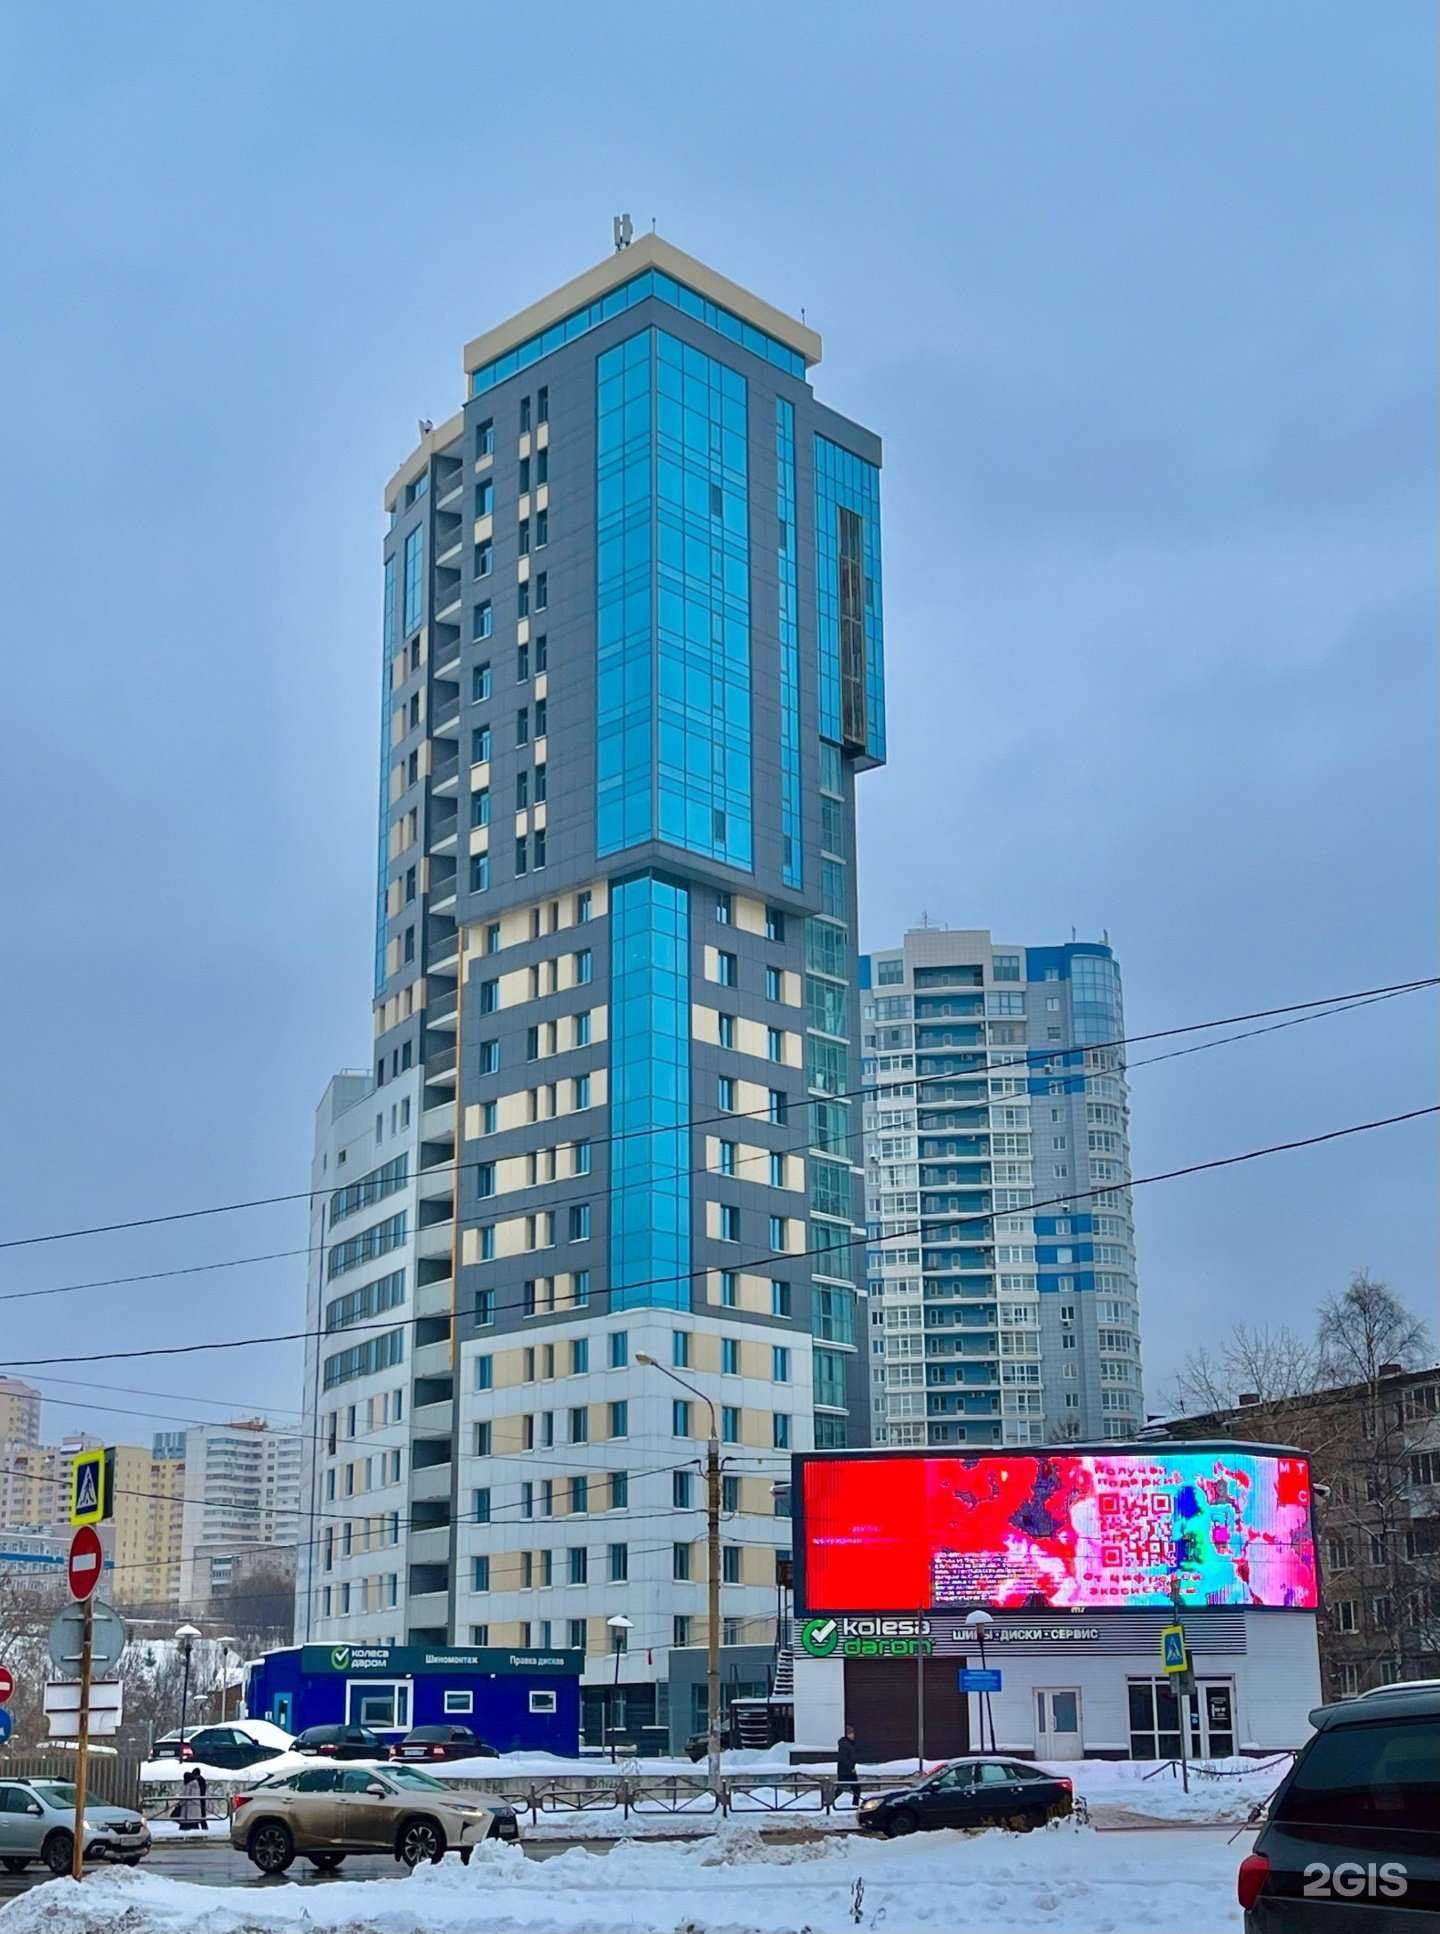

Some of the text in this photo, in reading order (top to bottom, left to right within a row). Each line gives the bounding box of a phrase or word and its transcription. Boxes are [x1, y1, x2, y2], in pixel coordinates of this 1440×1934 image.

[843, 1618, 930, 1635] kolesa
[952, 1628, 1099, 1642] ШИЫ ДИСКИ СЕРВИС
[844, 1638, 933, 1655] darom
[351, 1649, 389, 1658] колеса
[425, 1655, 478, 1664] Шиномонтаж
[351, 1659, 387, 1669] даром
